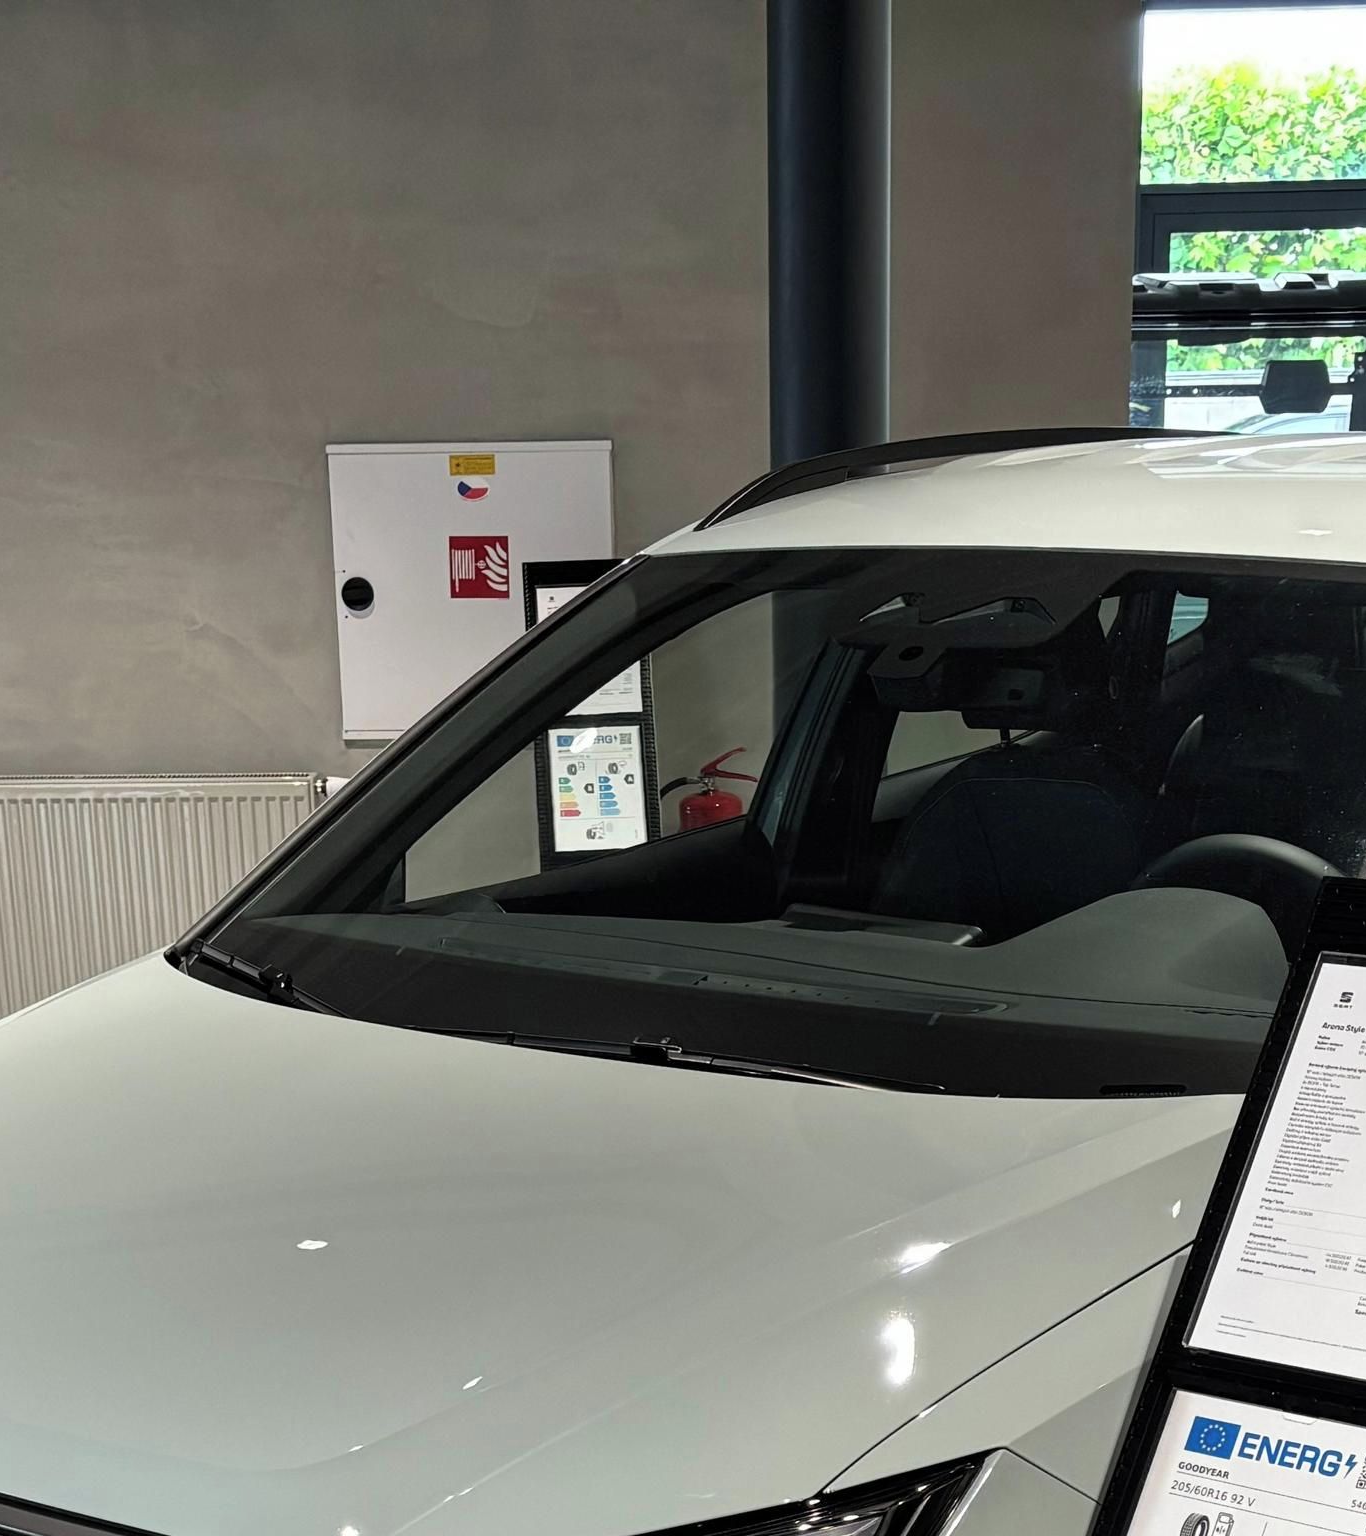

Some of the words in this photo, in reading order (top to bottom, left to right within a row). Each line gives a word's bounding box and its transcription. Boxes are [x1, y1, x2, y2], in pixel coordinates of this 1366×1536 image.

[1322, 1022, 1345, 1031] Arona
[1345, 1024, 1365, 1034] Style
[1237, 1431, 1343, 1477] ENERG
[1178, 1461, 1230, 1479] GOODYEAR
[1171, 1479, 1227, 1501] 205/60R16
[1230, 1493, 1244, 1505] 92
[1247, 1497, 1256, 1507] V
